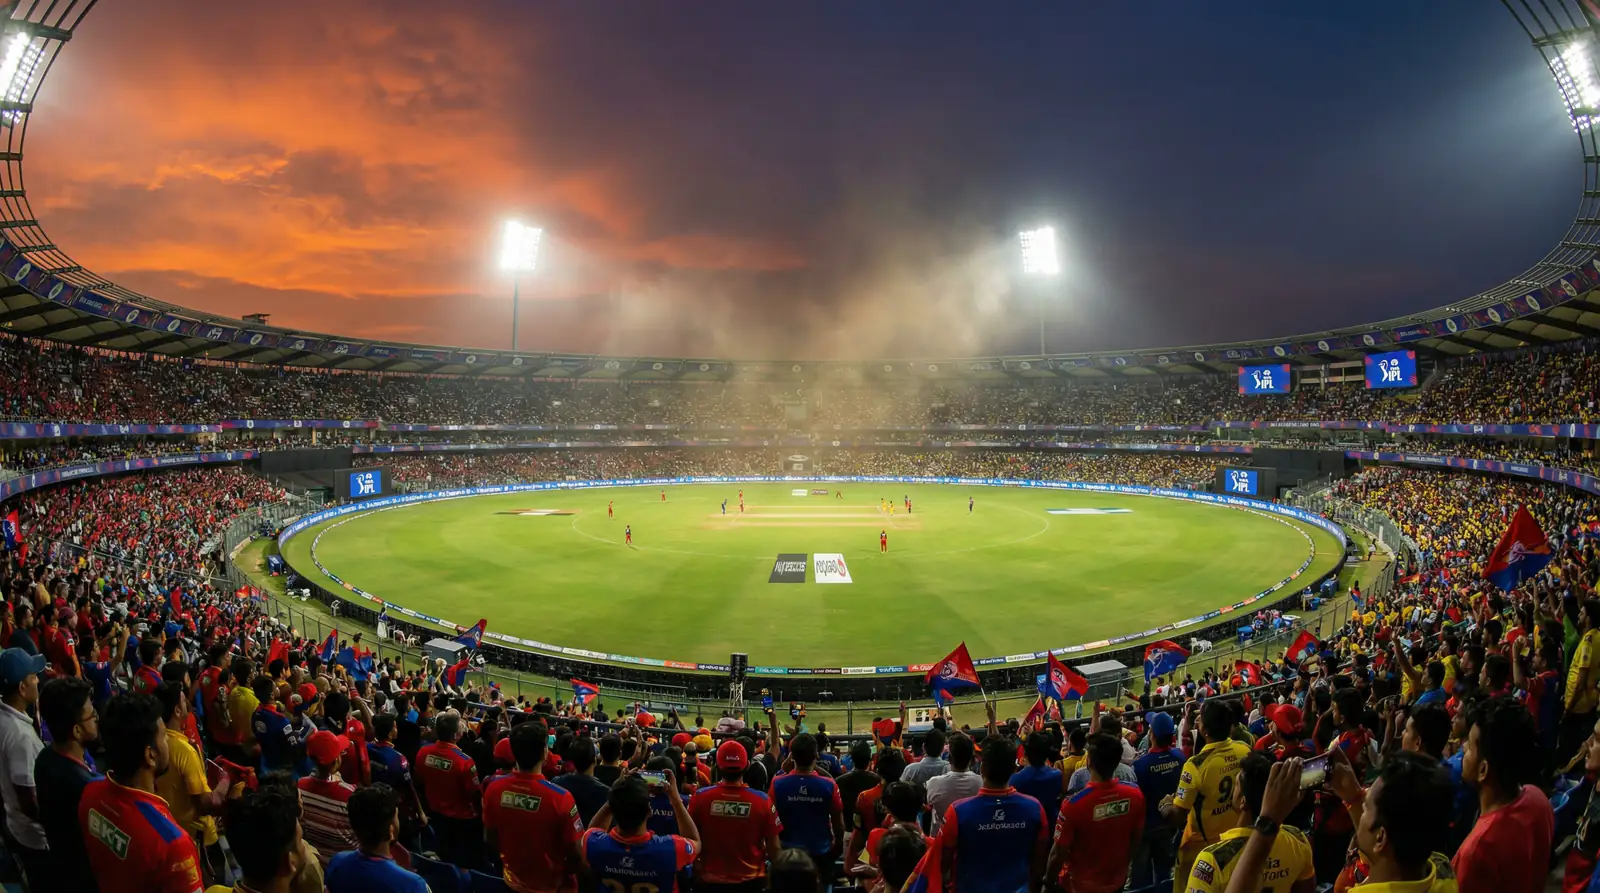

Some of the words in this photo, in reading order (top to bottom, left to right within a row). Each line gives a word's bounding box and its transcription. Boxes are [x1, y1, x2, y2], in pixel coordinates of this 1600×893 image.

[1388, 370, 1403, 382] IPL
[1261, 379, 1274, 389] IPL
[1238, 482, 1250, 493] IPL
[502, 794, 539, 811] BKT
[712, 802, 750, 816] BKT
[1095, 801, 1129, 817] BKT
[90, 814, 127, 852] BKT
